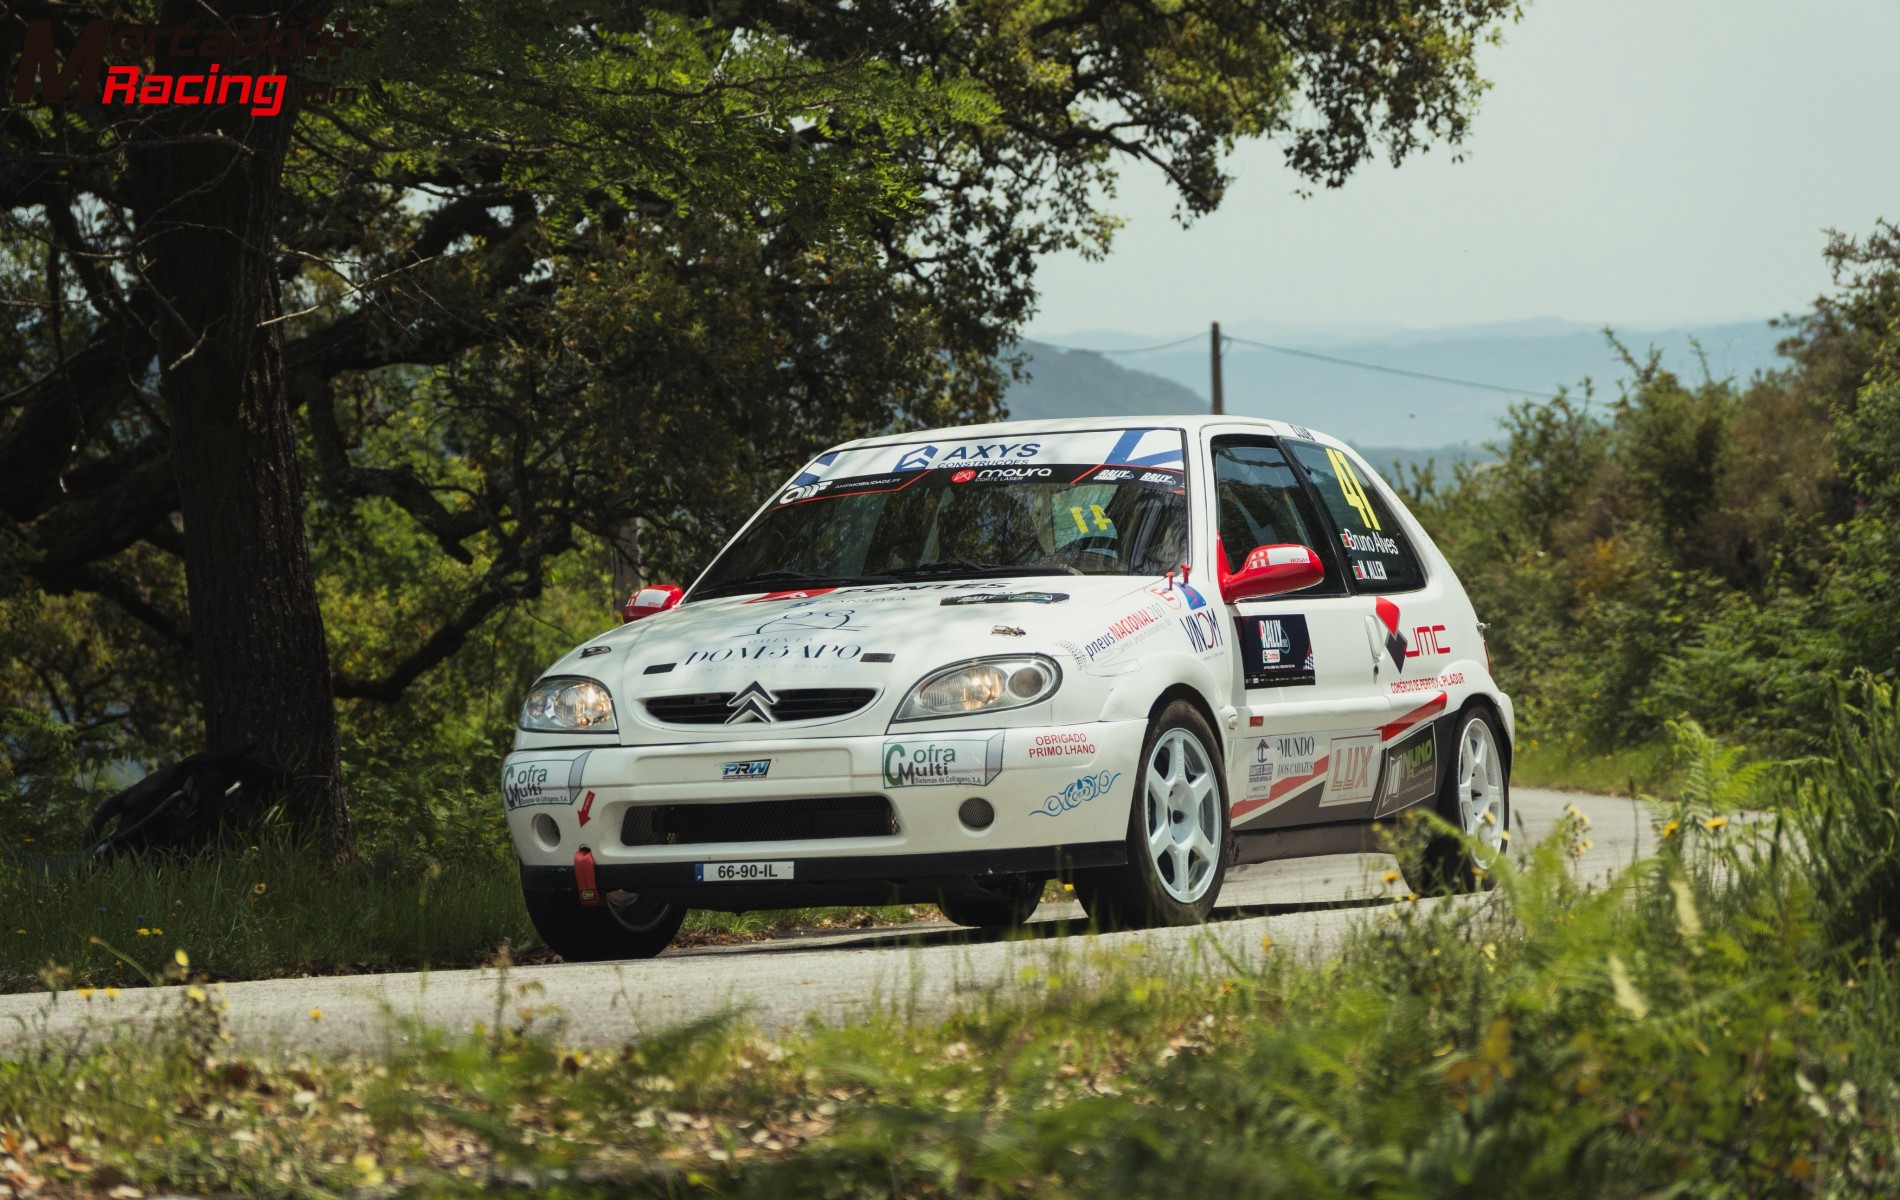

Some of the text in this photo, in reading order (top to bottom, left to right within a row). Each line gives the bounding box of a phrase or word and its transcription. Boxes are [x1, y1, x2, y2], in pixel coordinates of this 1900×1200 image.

[943, 442, 1041, 462] AXYS
[977, 467, 1053, 478] moura
[1099, 469, 1130, 478] RALLY
[1140, 472, 1173, 482] RALLY
[1325, 448, 1382, 531] 41
[1344, 528, 1399, 556] Bruno Alves
[1261, 619, 1283, 649] RALLY
[1405, 624, 1452, 658] JMC
[684, 646, 769, 666] DOM
[1028, 743, 1096, 758] PRIMO LHANO
[1035, 733, 1087, 747] OBRIGADO
[1277, 736, 1315, 759] MUNDO
[720, 761, 769, 776] PRW
[884, 744, 956, 787] Cofra
[898, 762, 949, 786] Multi
[503, 765, 548, 808] Cofra
[508, 782, 542, 806] Multi
[717, 864, 778, 879] 66-90-IL
